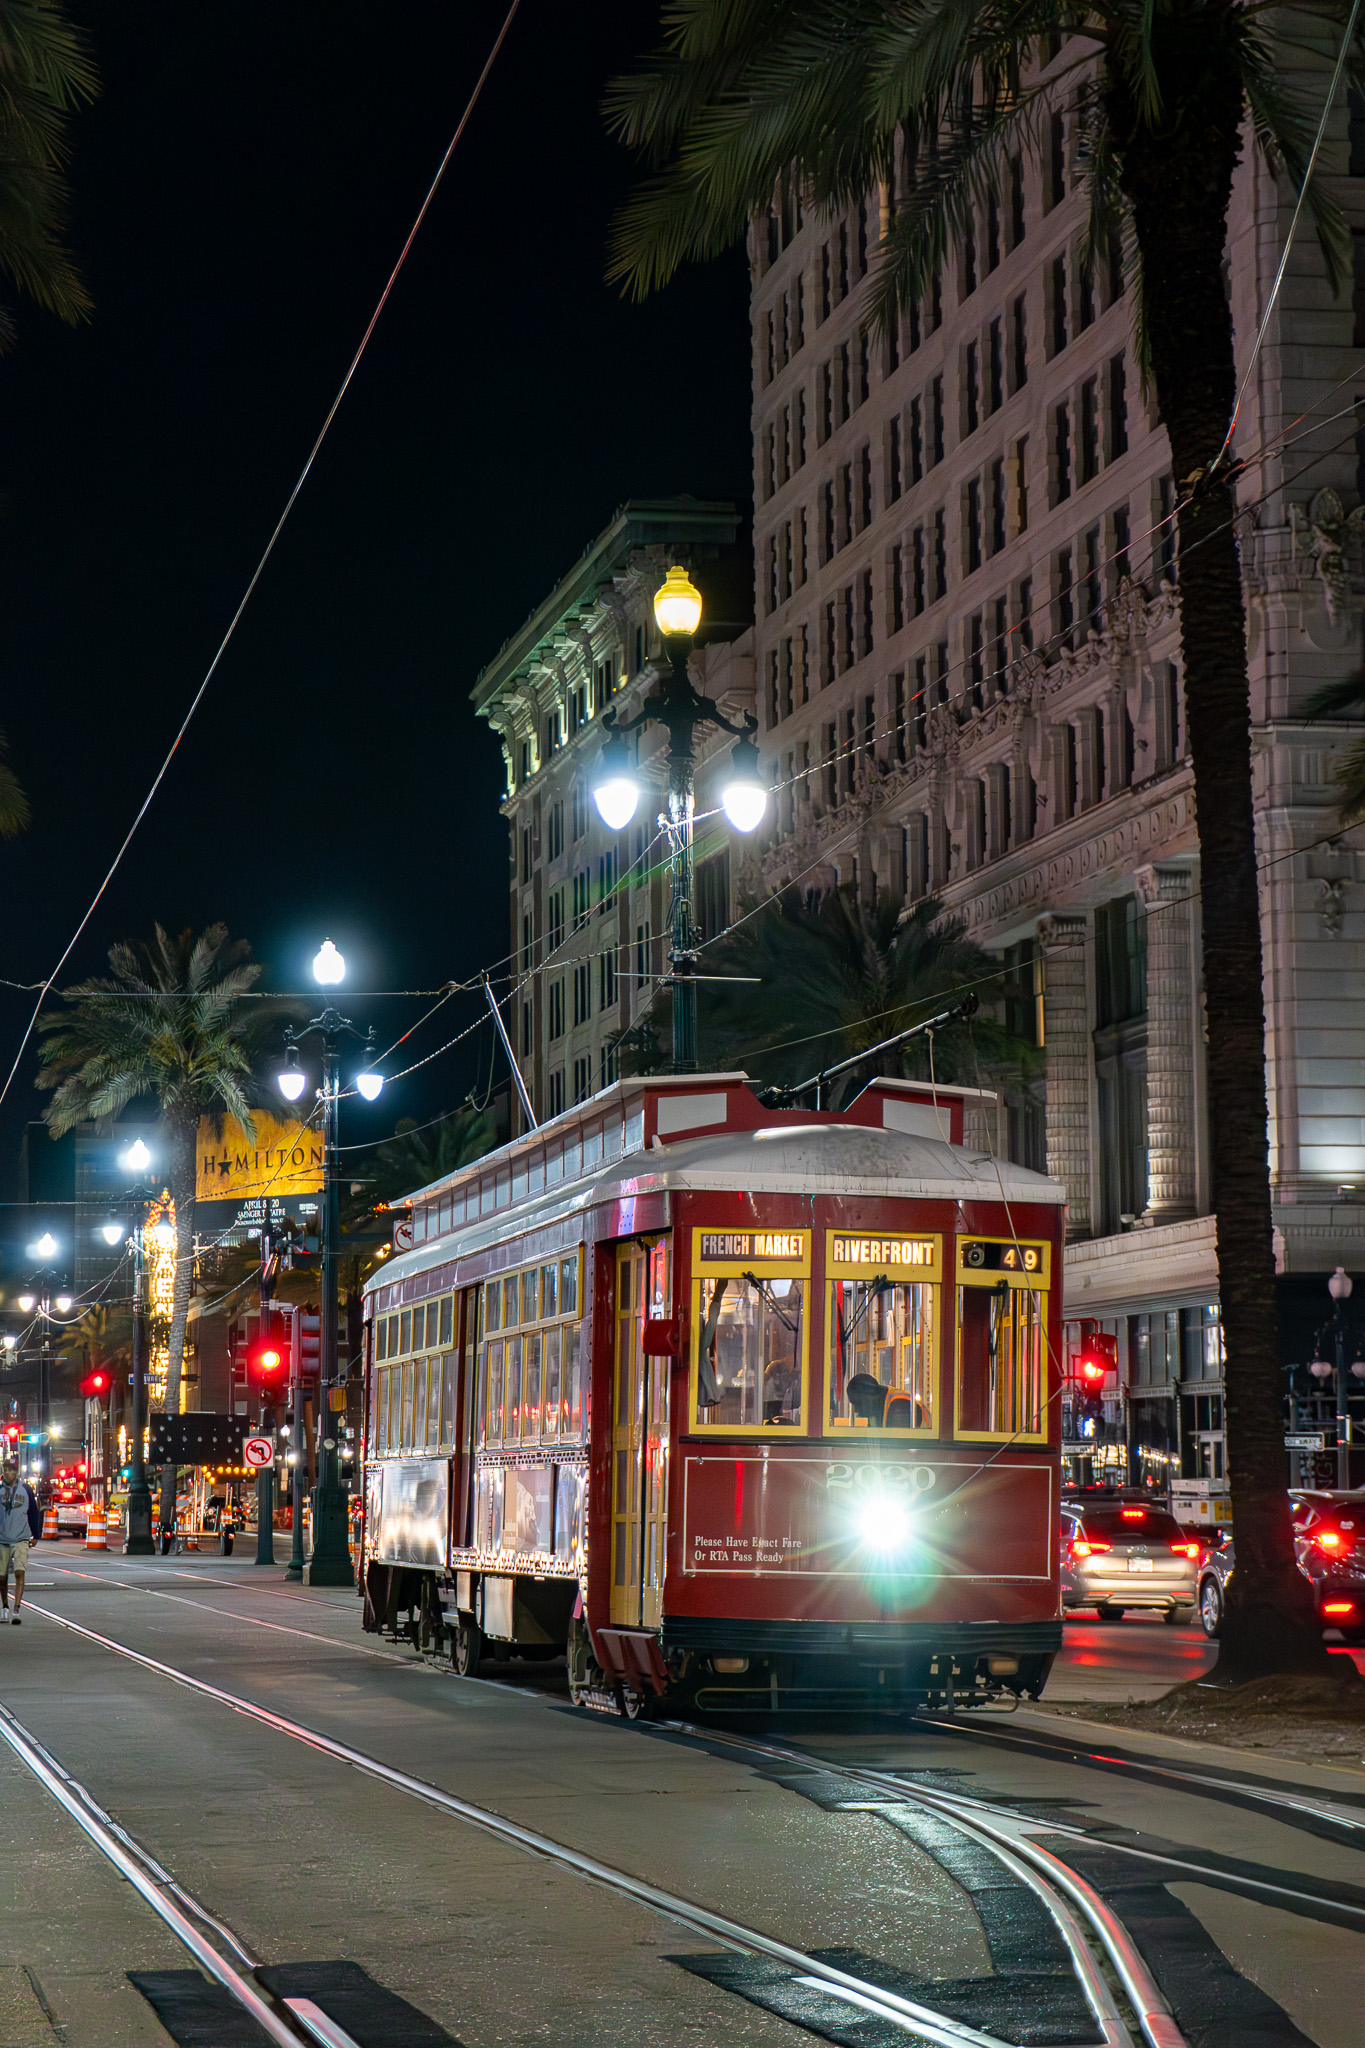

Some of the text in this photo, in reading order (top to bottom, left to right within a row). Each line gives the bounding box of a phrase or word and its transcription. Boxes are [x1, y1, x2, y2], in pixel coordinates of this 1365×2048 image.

[702, 1234, 804, 1256] FRENCH MARKET
[833, 1239, 935, 1265] RIVERFRONT
[1003, 1248, 1038, 1270] 49
[826, 1463, 936, 1491] 2020
[694, 1535, 722, 1547] Please
[725, 1536, 748, 1547] Have
[782, 1537, 802, 1548] Fare
[694, 1550, 784, 1564] Or RTA Pass Ready
